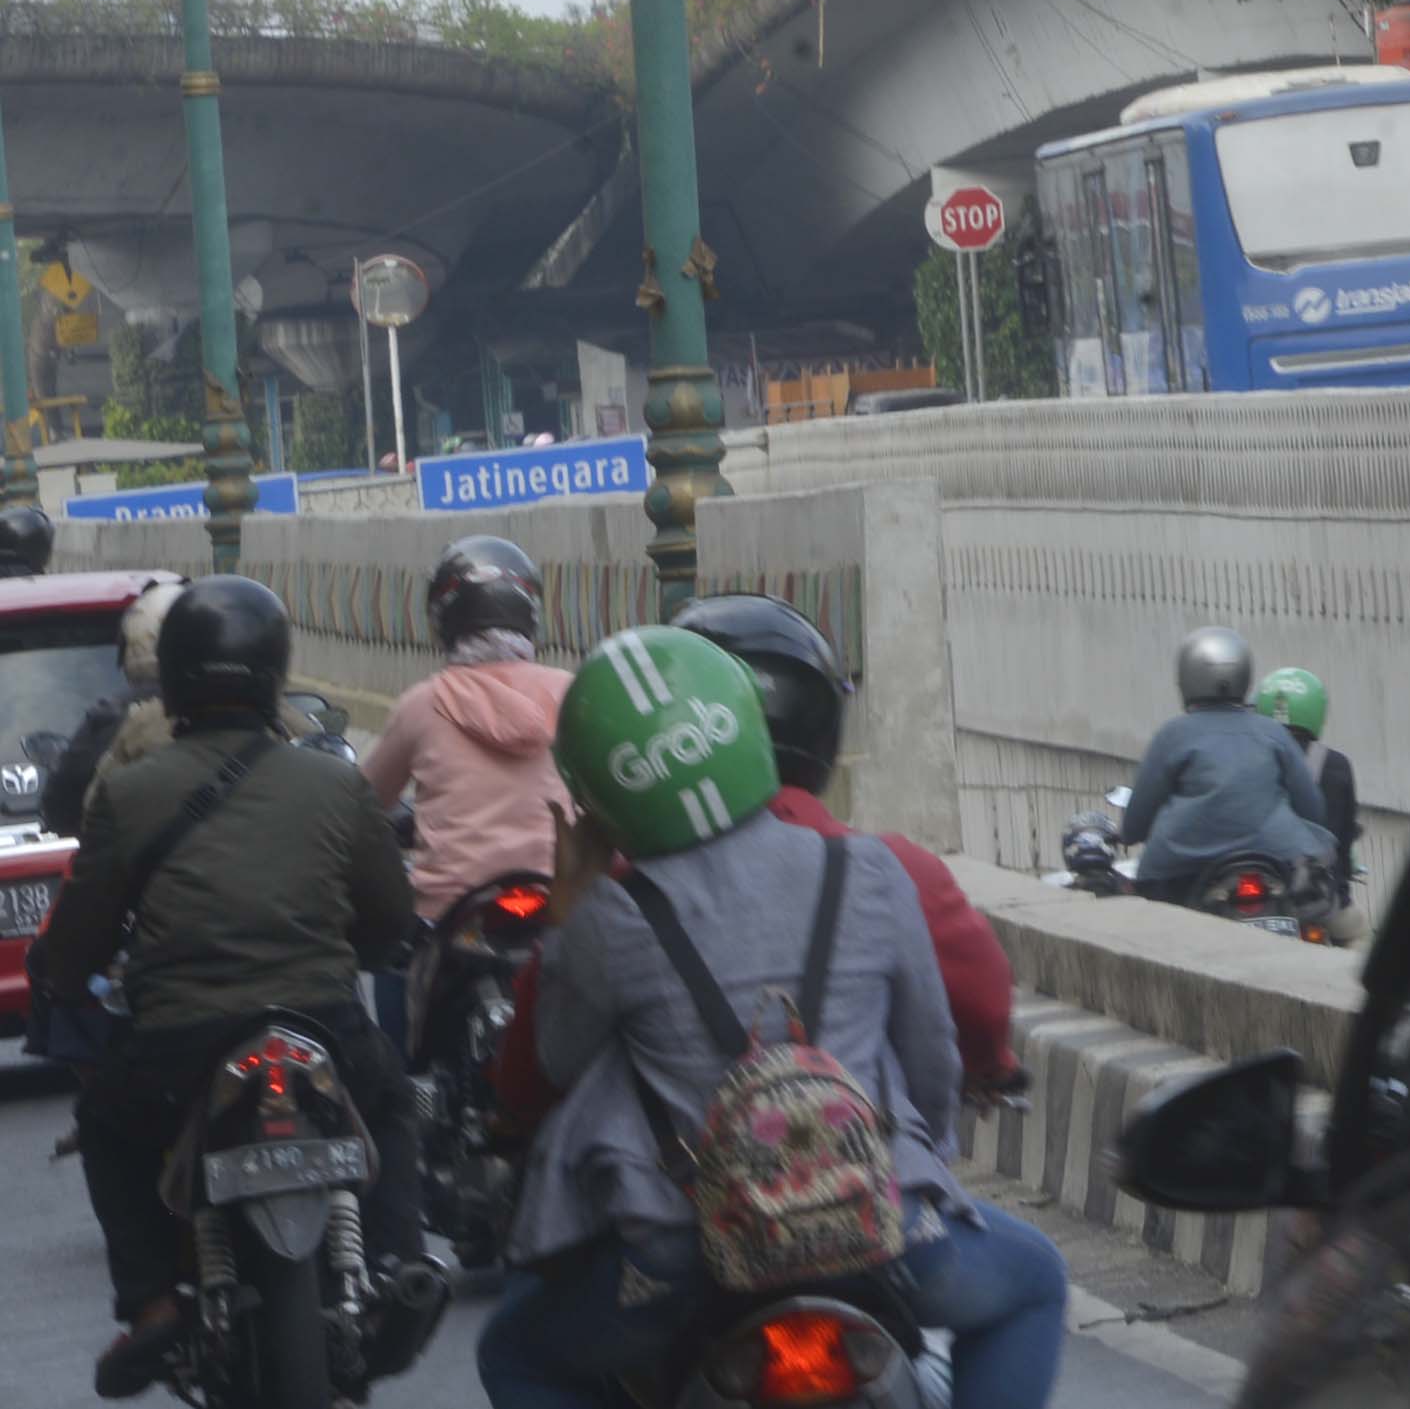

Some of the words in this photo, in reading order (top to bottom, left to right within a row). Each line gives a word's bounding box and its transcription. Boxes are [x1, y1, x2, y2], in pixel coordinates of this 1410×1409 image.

[944, 203, 999, 235] STOP
[440, 455, 631, 505] Jatinegara
[607, 695, 739, 791] Grab
